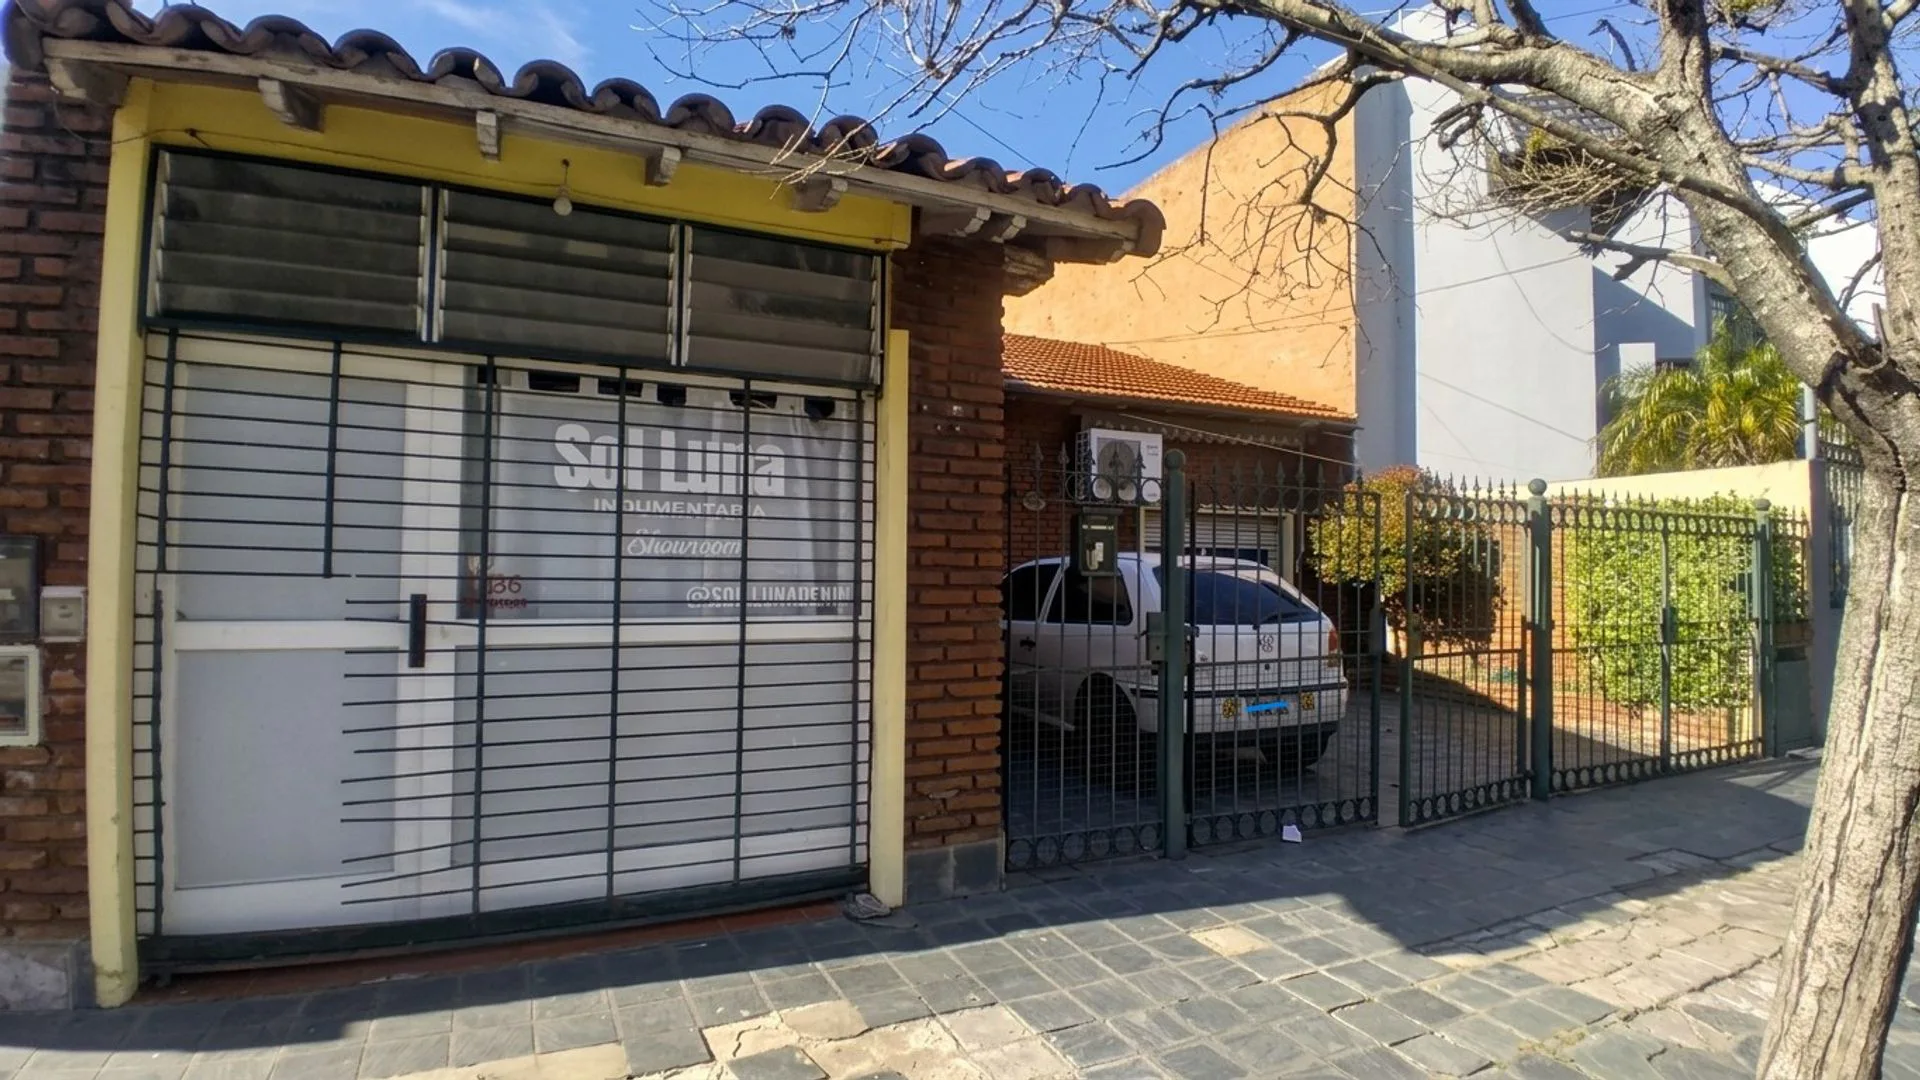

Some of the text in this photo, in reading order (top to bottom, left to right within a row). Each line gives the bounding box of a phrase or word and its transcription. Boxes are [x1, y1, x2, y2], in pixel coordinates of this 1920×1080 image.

[554, 423, 786, 498] Sol Luna
[593, 498, 767, 521] INDUMENTARA
[626, 527, 744, 557] Showroom
